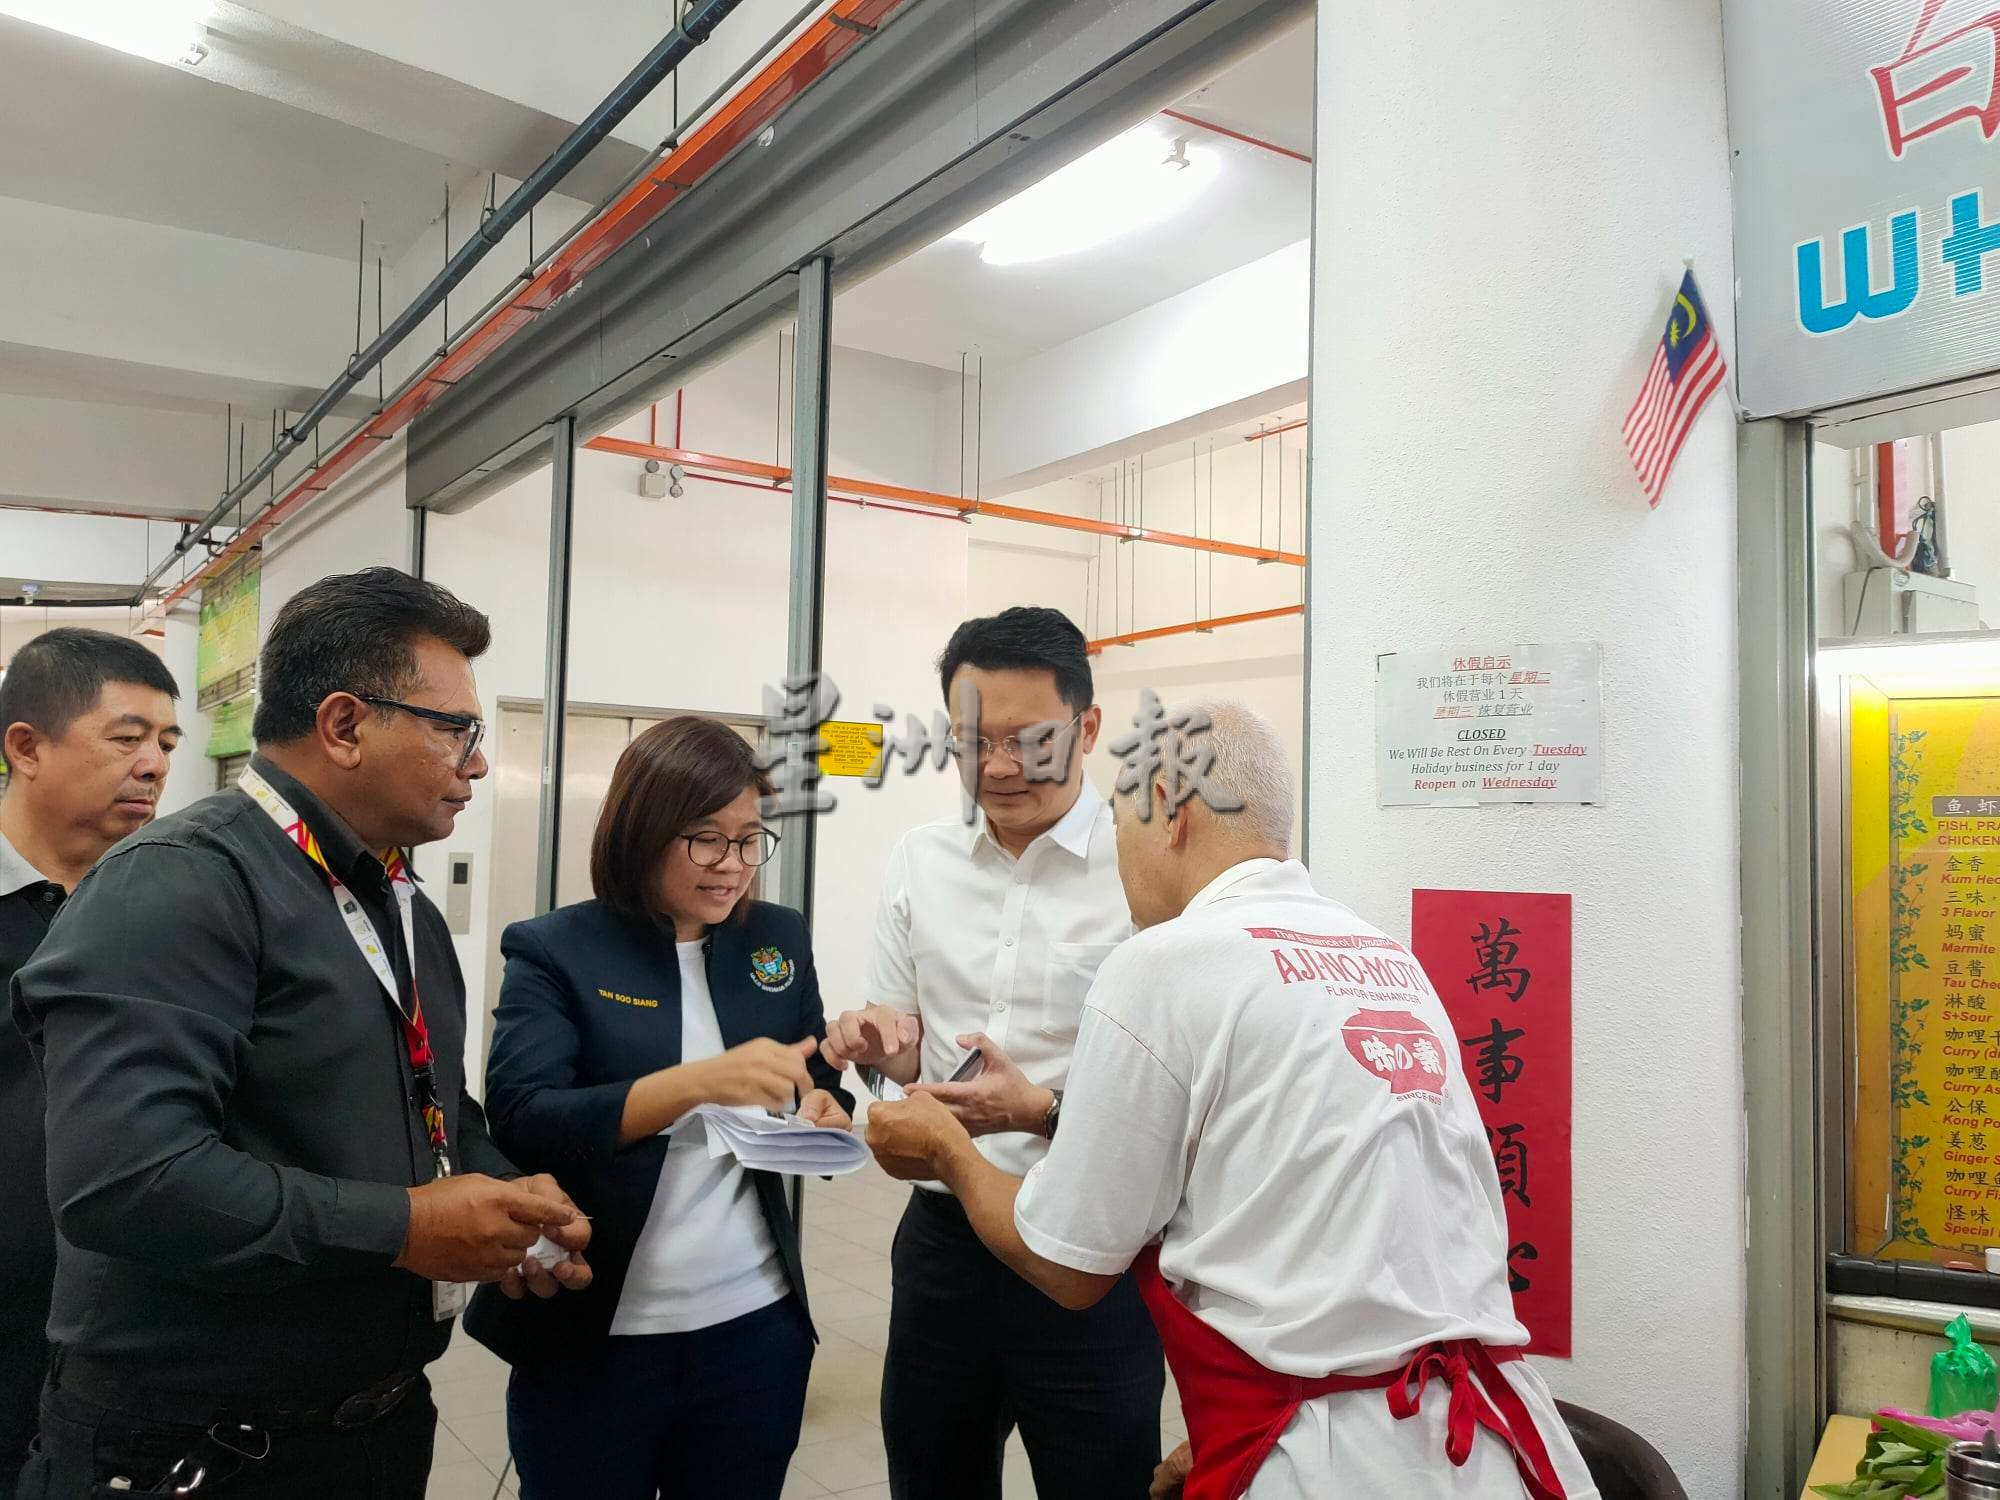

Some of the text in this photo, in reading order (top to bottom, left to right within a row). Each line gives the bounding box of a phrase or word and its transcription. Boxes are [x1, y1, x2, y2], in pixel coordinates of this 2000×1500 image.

[1452, 655, 1512, 671] 休假启示
[1457, 728, 1507, 741] CLOSED
[1389, 744, 1587, 760] We Will Be Rest On Every Tuesday
[1411, 759, 1560, 775] Holiday business for 1 day
[1414, 776, 1557, 792] Reopen on Wednesday
[1937, 835, 2000, 846] CHICKEN
[1941, 873, 1972, 884] Kum
[1944, 889, 1985, 906] 三味
[1941, 907, 1996, 918] 3 Flavor
[1941, 942, 1996, 954] Marmite
[1944, 959, 1985, 978] 豆酱
[1943, 977, 1966, 988] Tau
[597, 988, 659, 1008] TAN SOO SIANG
[1325, 985, 1422, 1005] FLAVOR ENHANCER
[1942, 1011, 1993, 1023] S+Sour
[1943, 1046, 1980, 1060] Curry
[1943, 1081, 1981, 1096] Curry
[1396, 1091, 1426, 1103] SINCE
[1943, 1114, 1979, 1129] Kong
[1943, 1150, 1990, 1166] Ginger
[1943, 1185, 1982, 1201] Curry
[1943, 1222, 1995, 1238] Special
